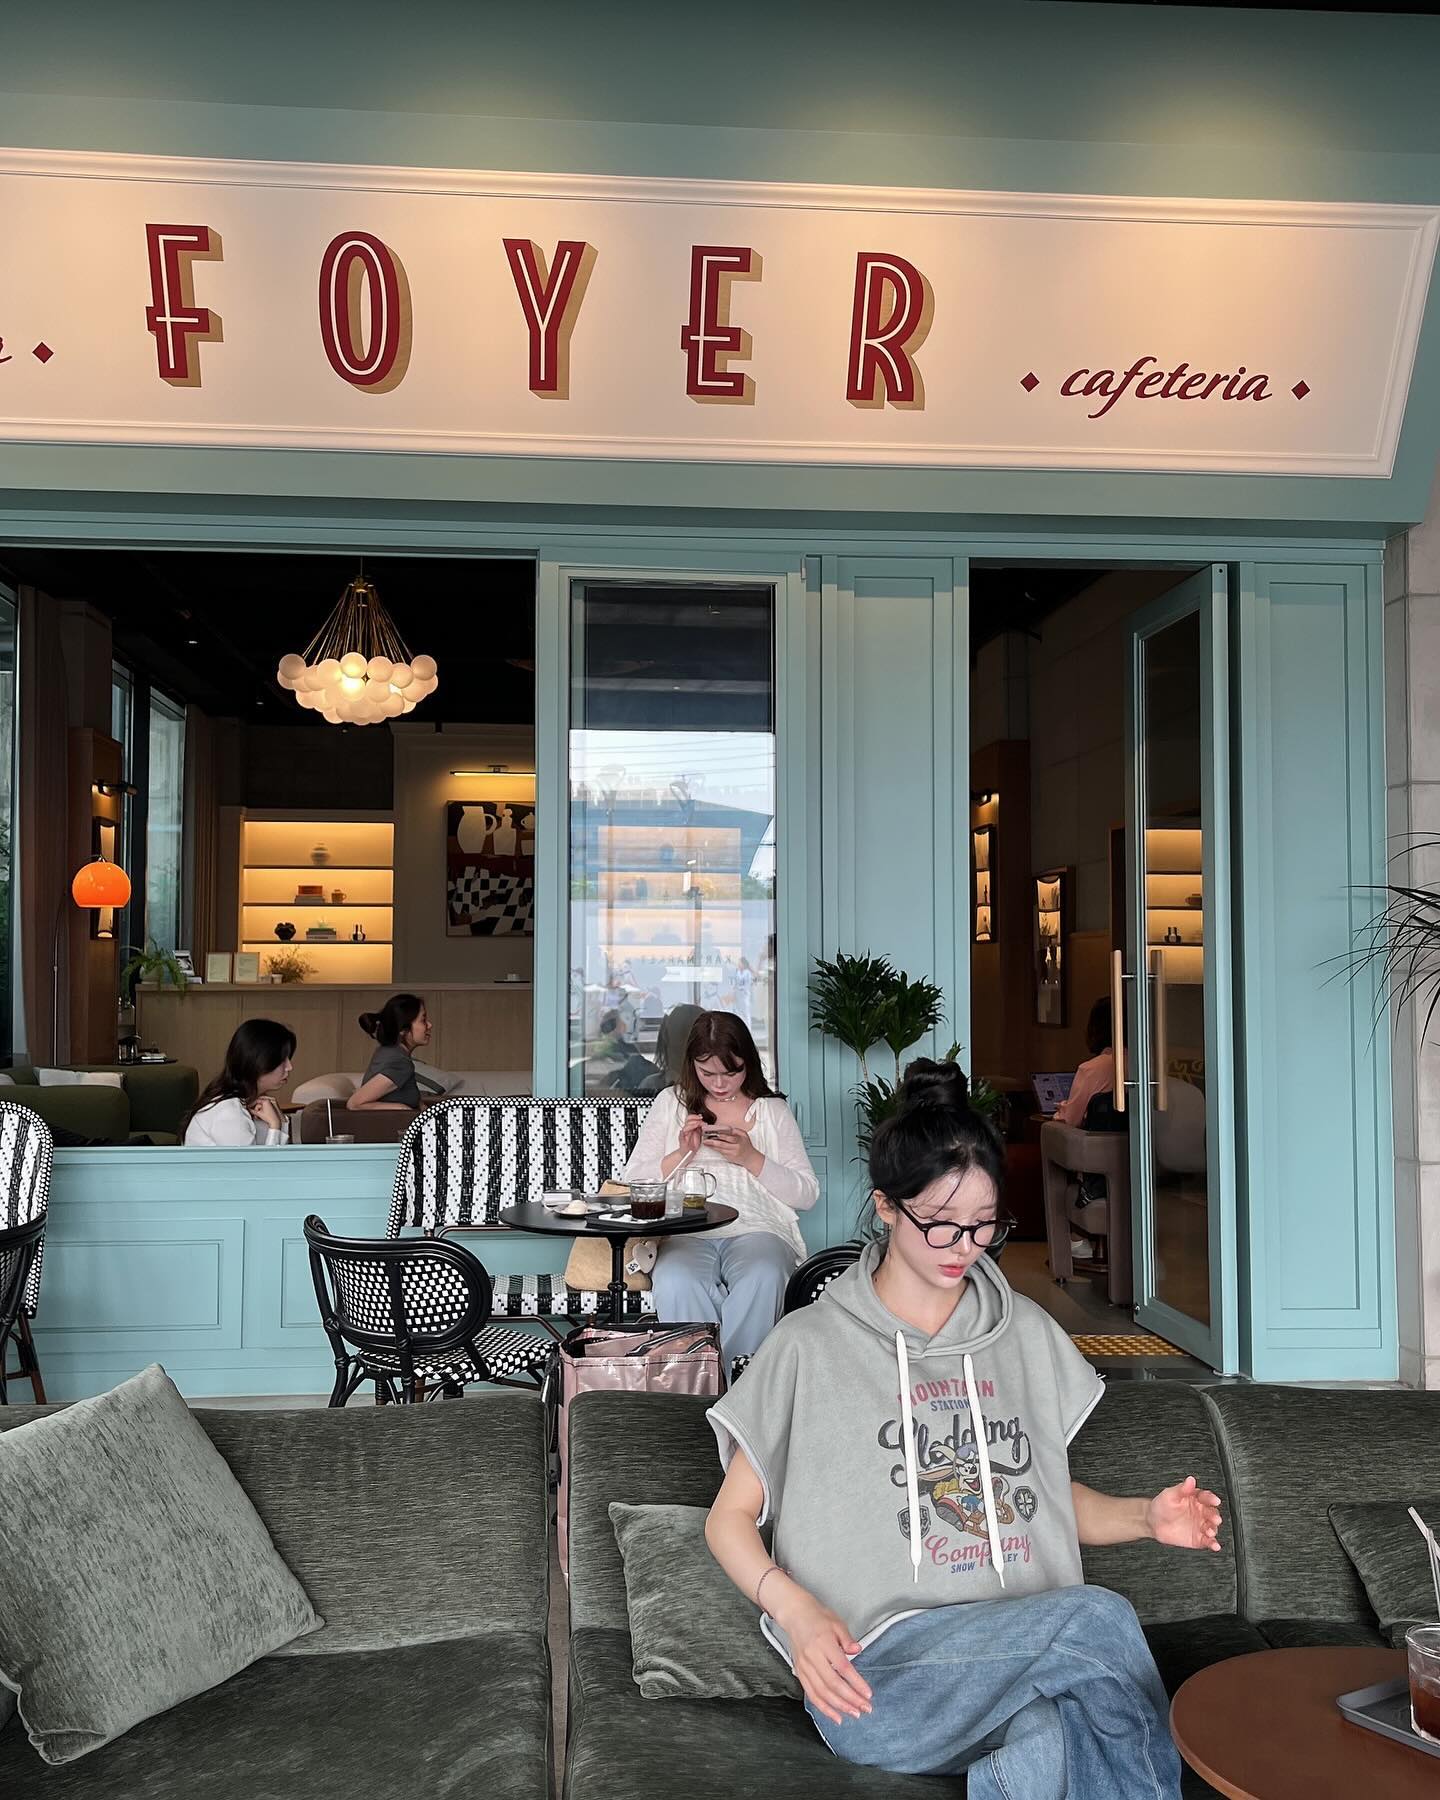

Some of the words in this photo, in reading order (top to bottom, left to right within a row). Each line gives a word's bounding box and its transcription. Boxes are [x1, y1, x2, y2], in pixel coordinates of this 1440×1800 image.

[145, 223, 935, 410] FOYER
[1060, 356, 1272, 418] cafeteria
[897, 1378, 995, 1406] OUNTN
[951, 1562, 976, 1574] SNOW
[988, 1553, 1018, 1566] VLEY
